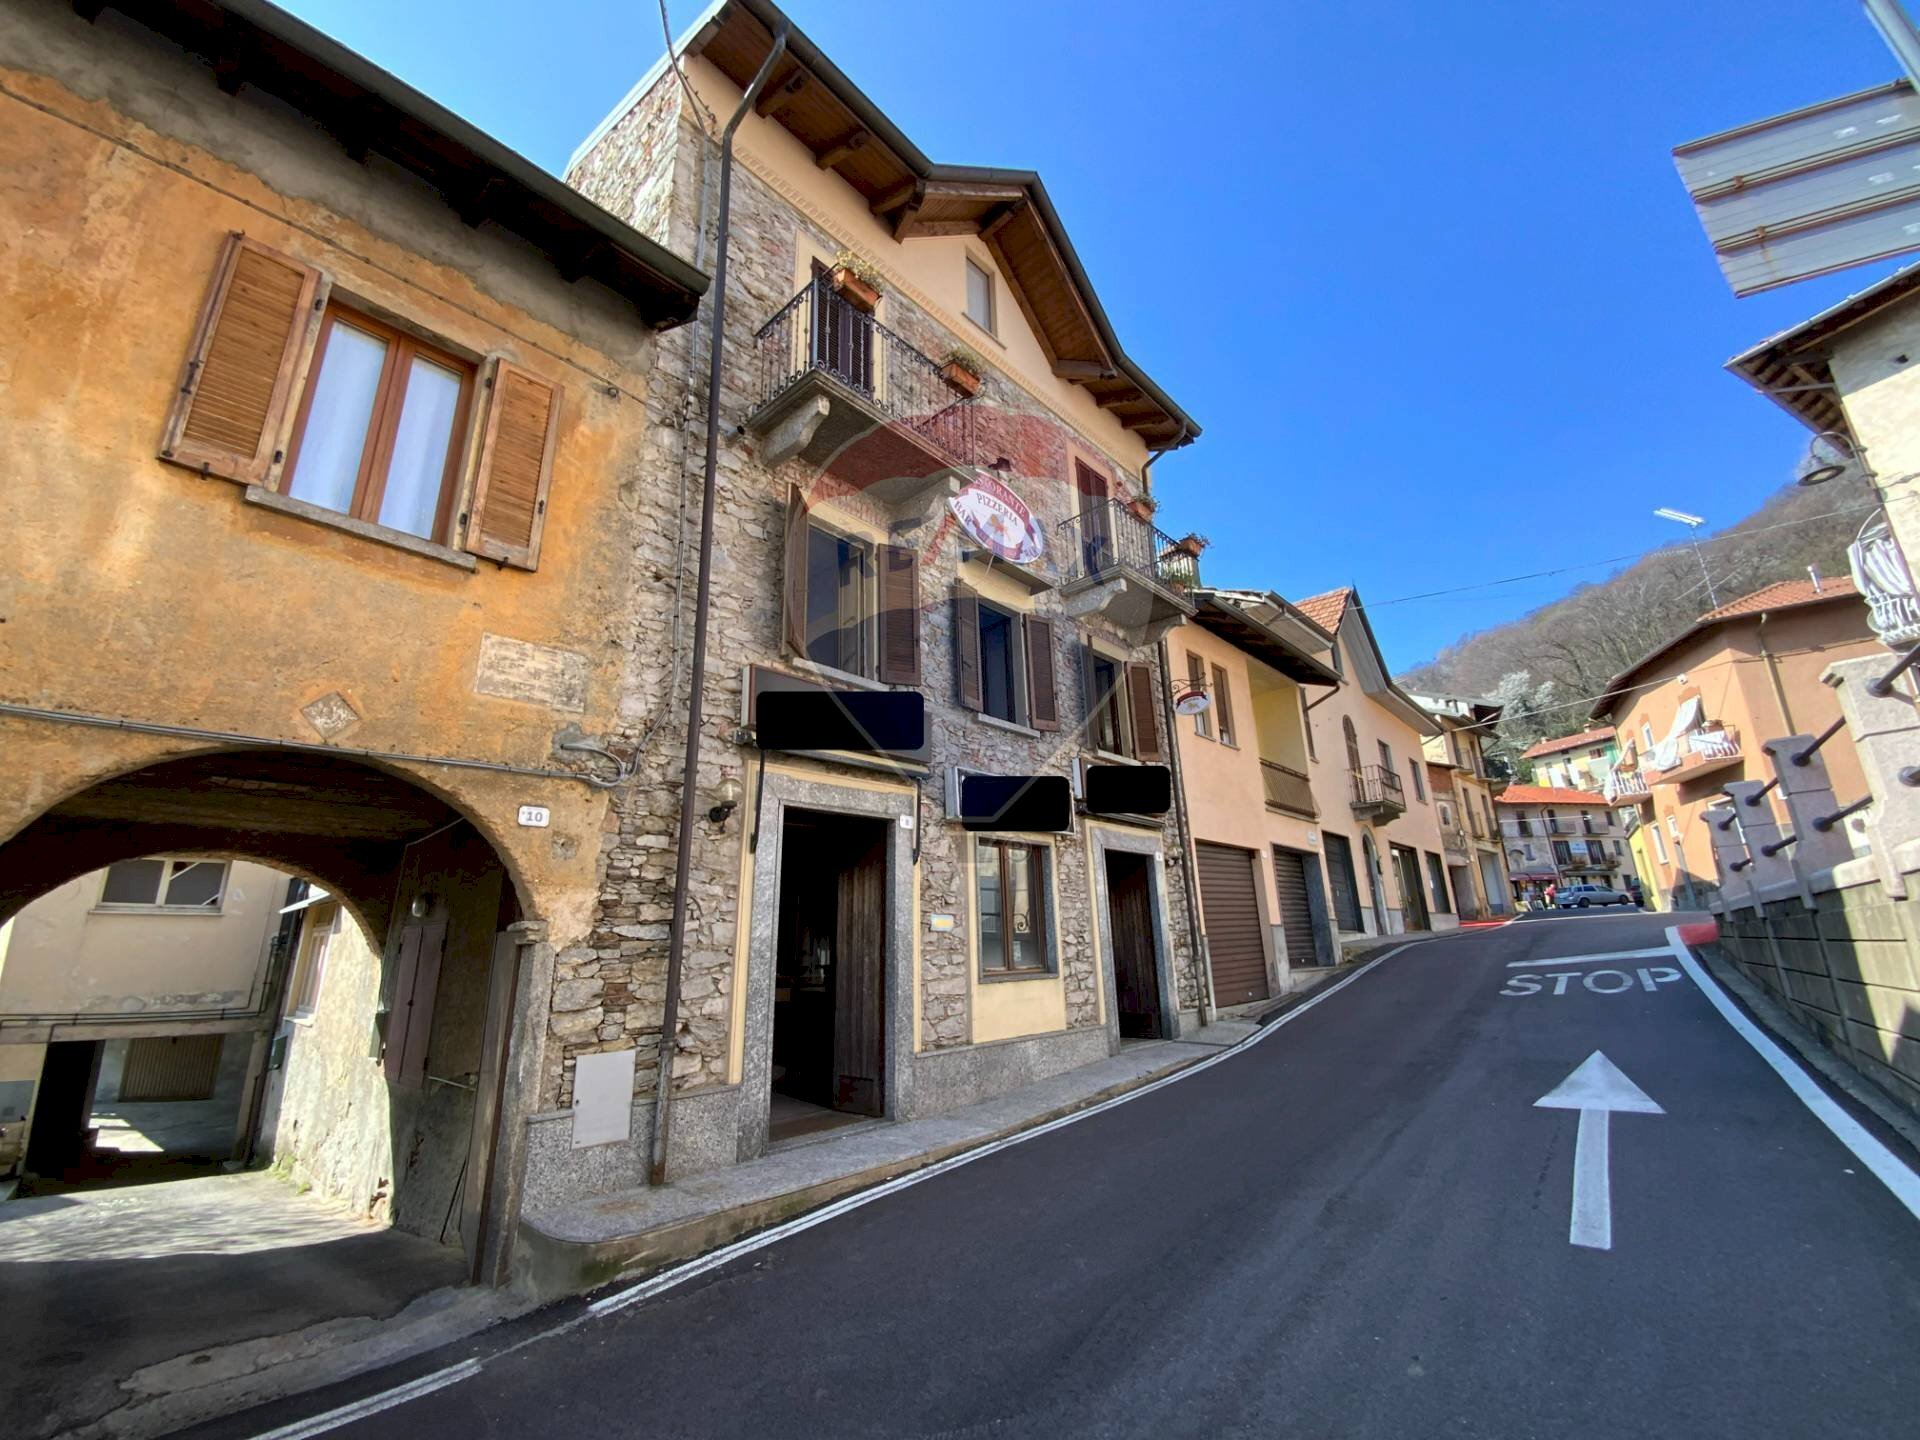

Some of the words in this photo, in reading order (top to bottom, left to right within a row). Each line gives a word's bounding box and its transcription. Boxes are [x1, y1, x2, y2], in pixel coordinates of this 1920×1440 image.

[954, 500, 974, 527] BAR
[976, 492, 1018, 527] PIZZERIA
[526, 811, 543, 822] 10
[1499, 967, 1682, 996] STOP
